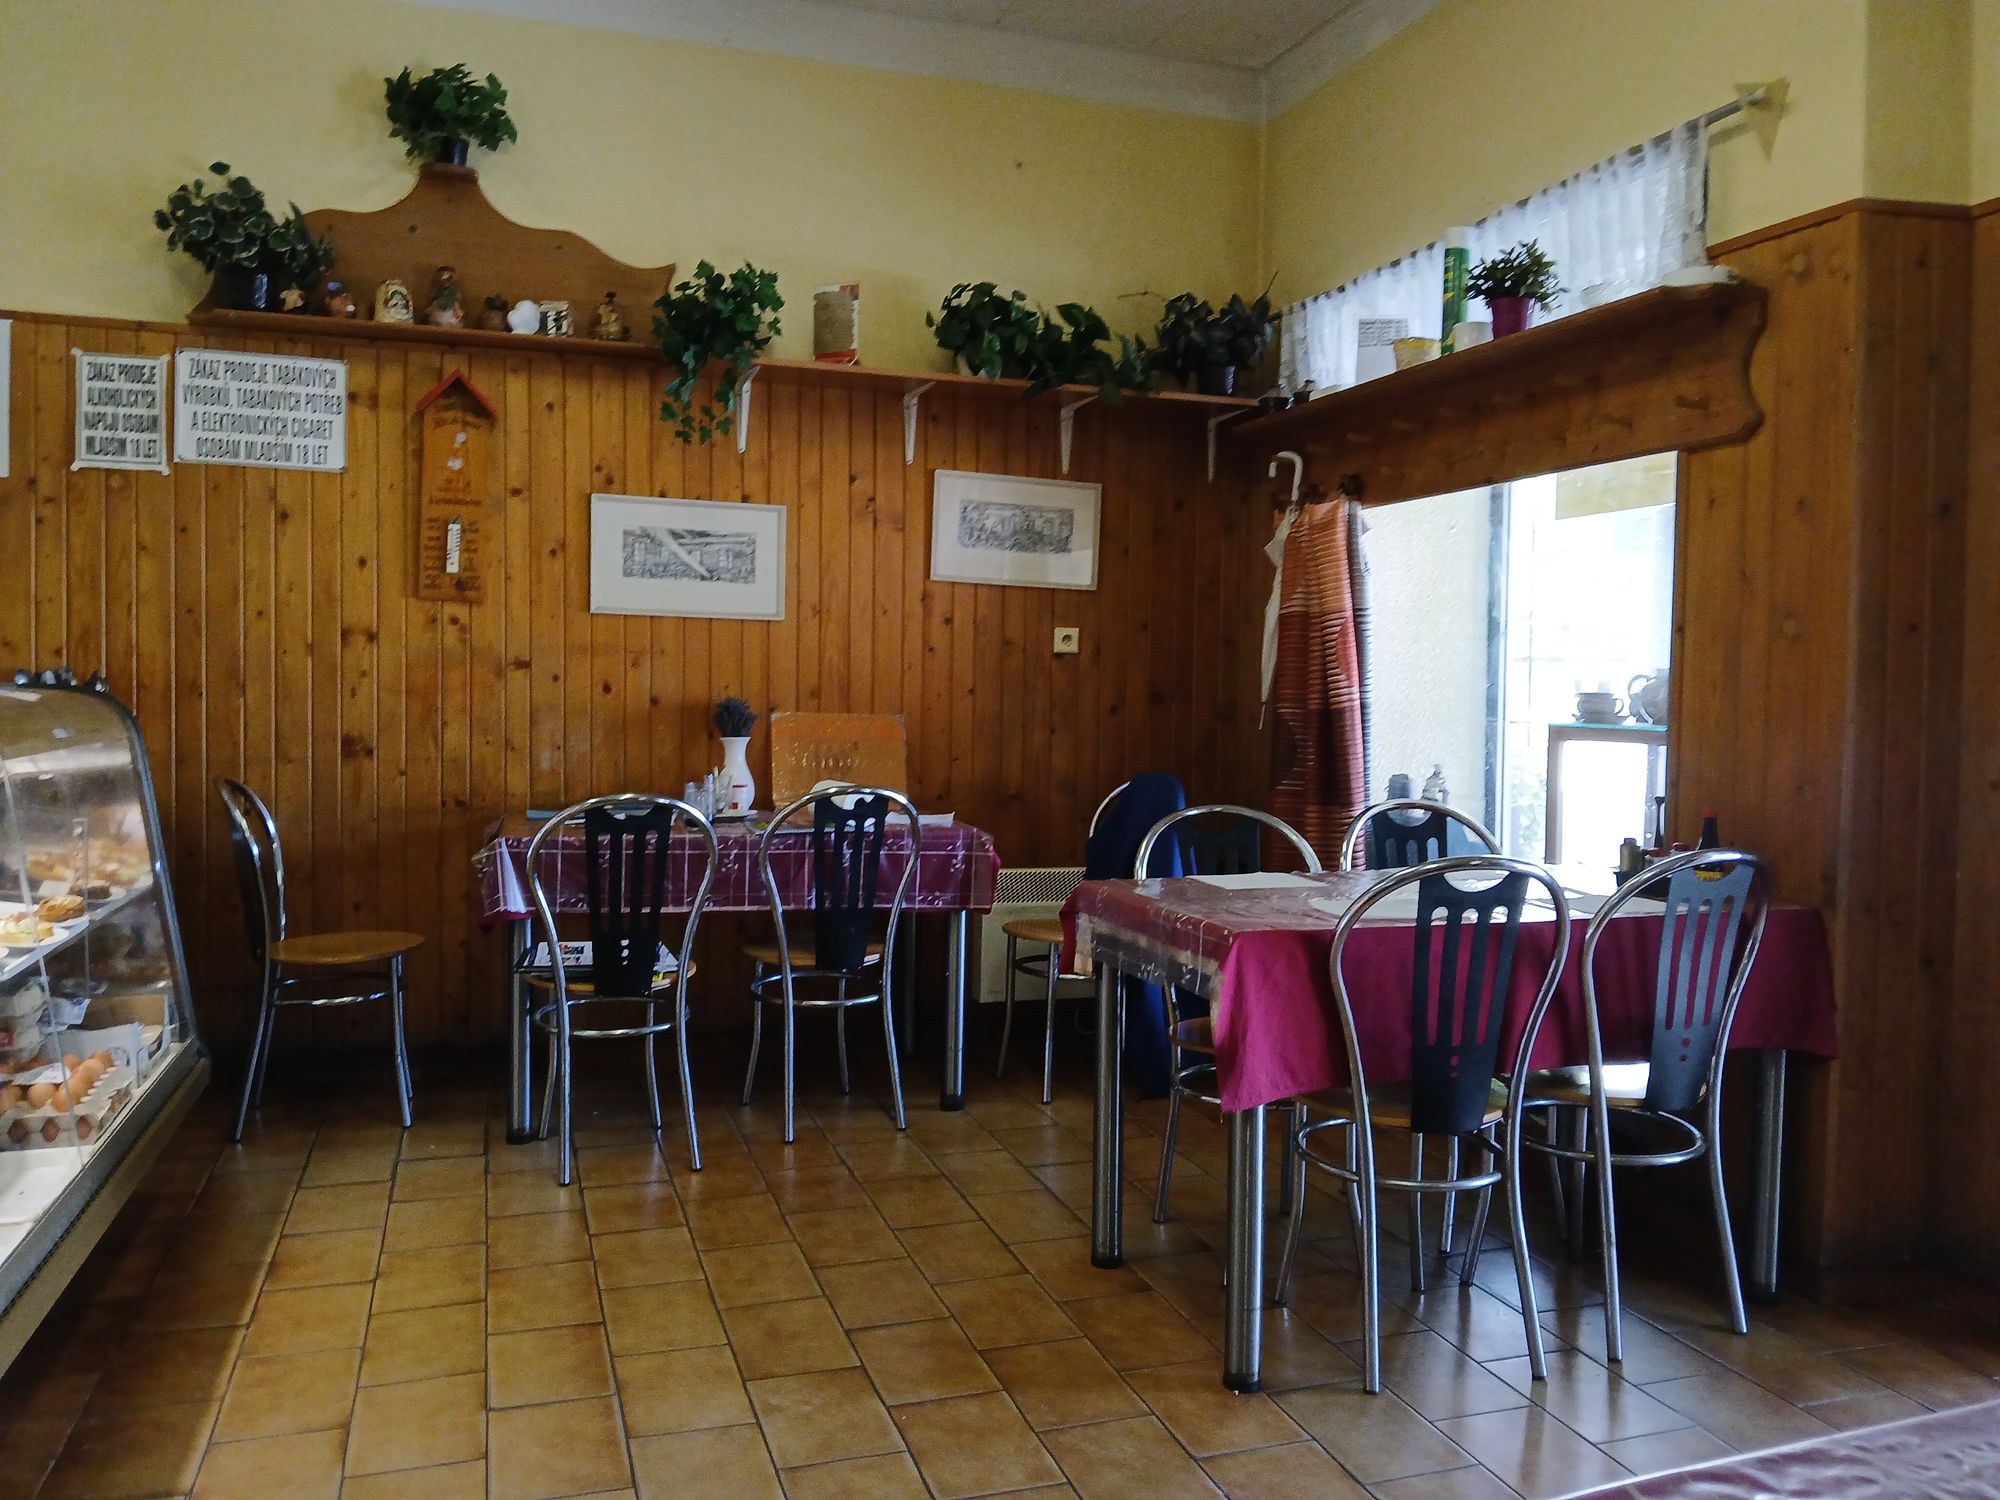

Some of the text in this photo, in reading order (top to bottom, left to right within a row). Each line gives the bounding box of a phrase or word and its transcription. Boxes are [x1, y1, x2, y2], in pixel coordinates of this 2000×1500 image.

[188, 353, 337, 390] ZÁKAZ PRODEJE TABÁKOVÝCH
[236, 385, 302, 413] TABÁKOVÝCH
[304, 390, 344, 416] POTŘEB
[190, 411, 334, 440] A ELEKTRONICKÝCH CIGARET
[142, 439, 158, 458] LET
[297, 445, 309, 464] 18
[312, 446, 329, 465] LET
